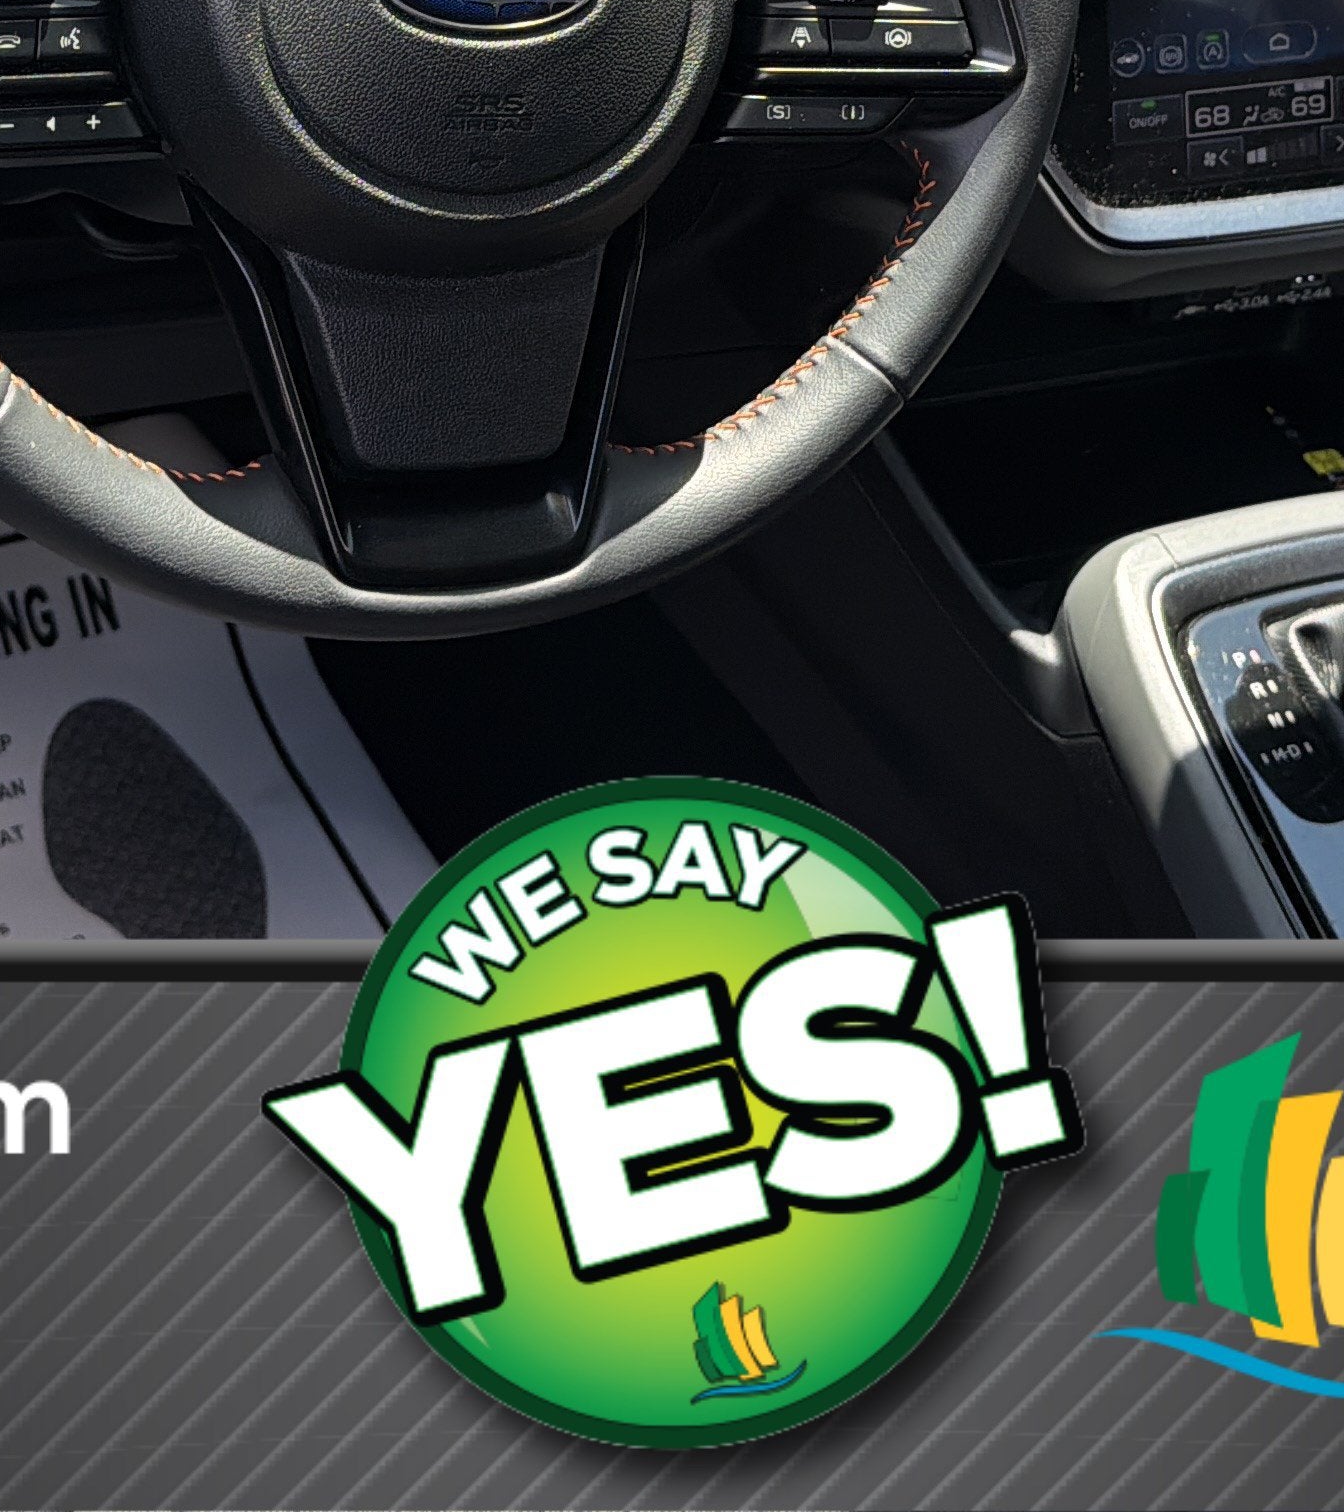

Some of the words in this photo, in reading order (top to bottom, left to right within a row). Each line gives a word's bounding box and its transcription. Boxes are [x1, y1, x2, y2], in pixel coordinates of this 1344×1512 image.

[1129, 114, 1168, 129] ON/OFF
[1194, 105, 1231, 128] 68
[1291, 94, 1327, 117] 69
[66, 572, 120, 639] IN
[1249, 681, 1269, 700] R
